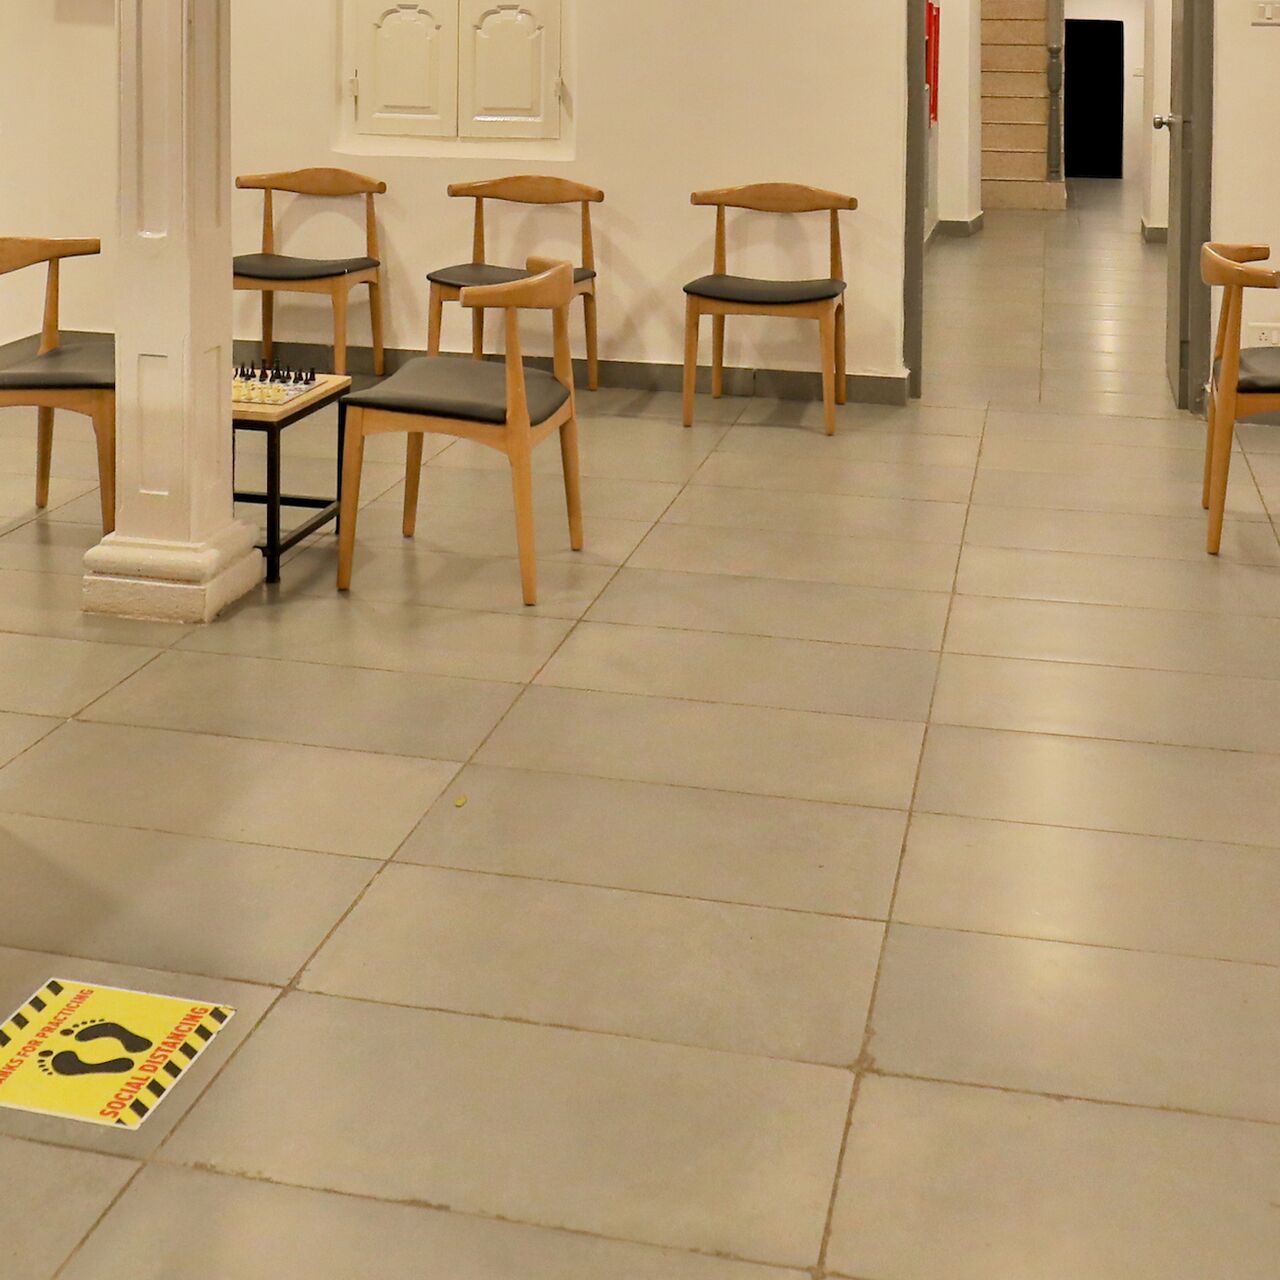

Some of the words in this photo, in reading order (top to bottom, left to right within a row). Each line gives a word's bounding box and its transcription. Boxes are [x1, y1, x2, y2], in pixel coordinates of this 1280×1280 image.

[16, 1039, 44, 1058] FOR
[35, 988, 95, 1039] PRACTICING
[99, 1075, 151, 1118] SOCIAL
[138, 1006, 209, 1074] DISTANCING
